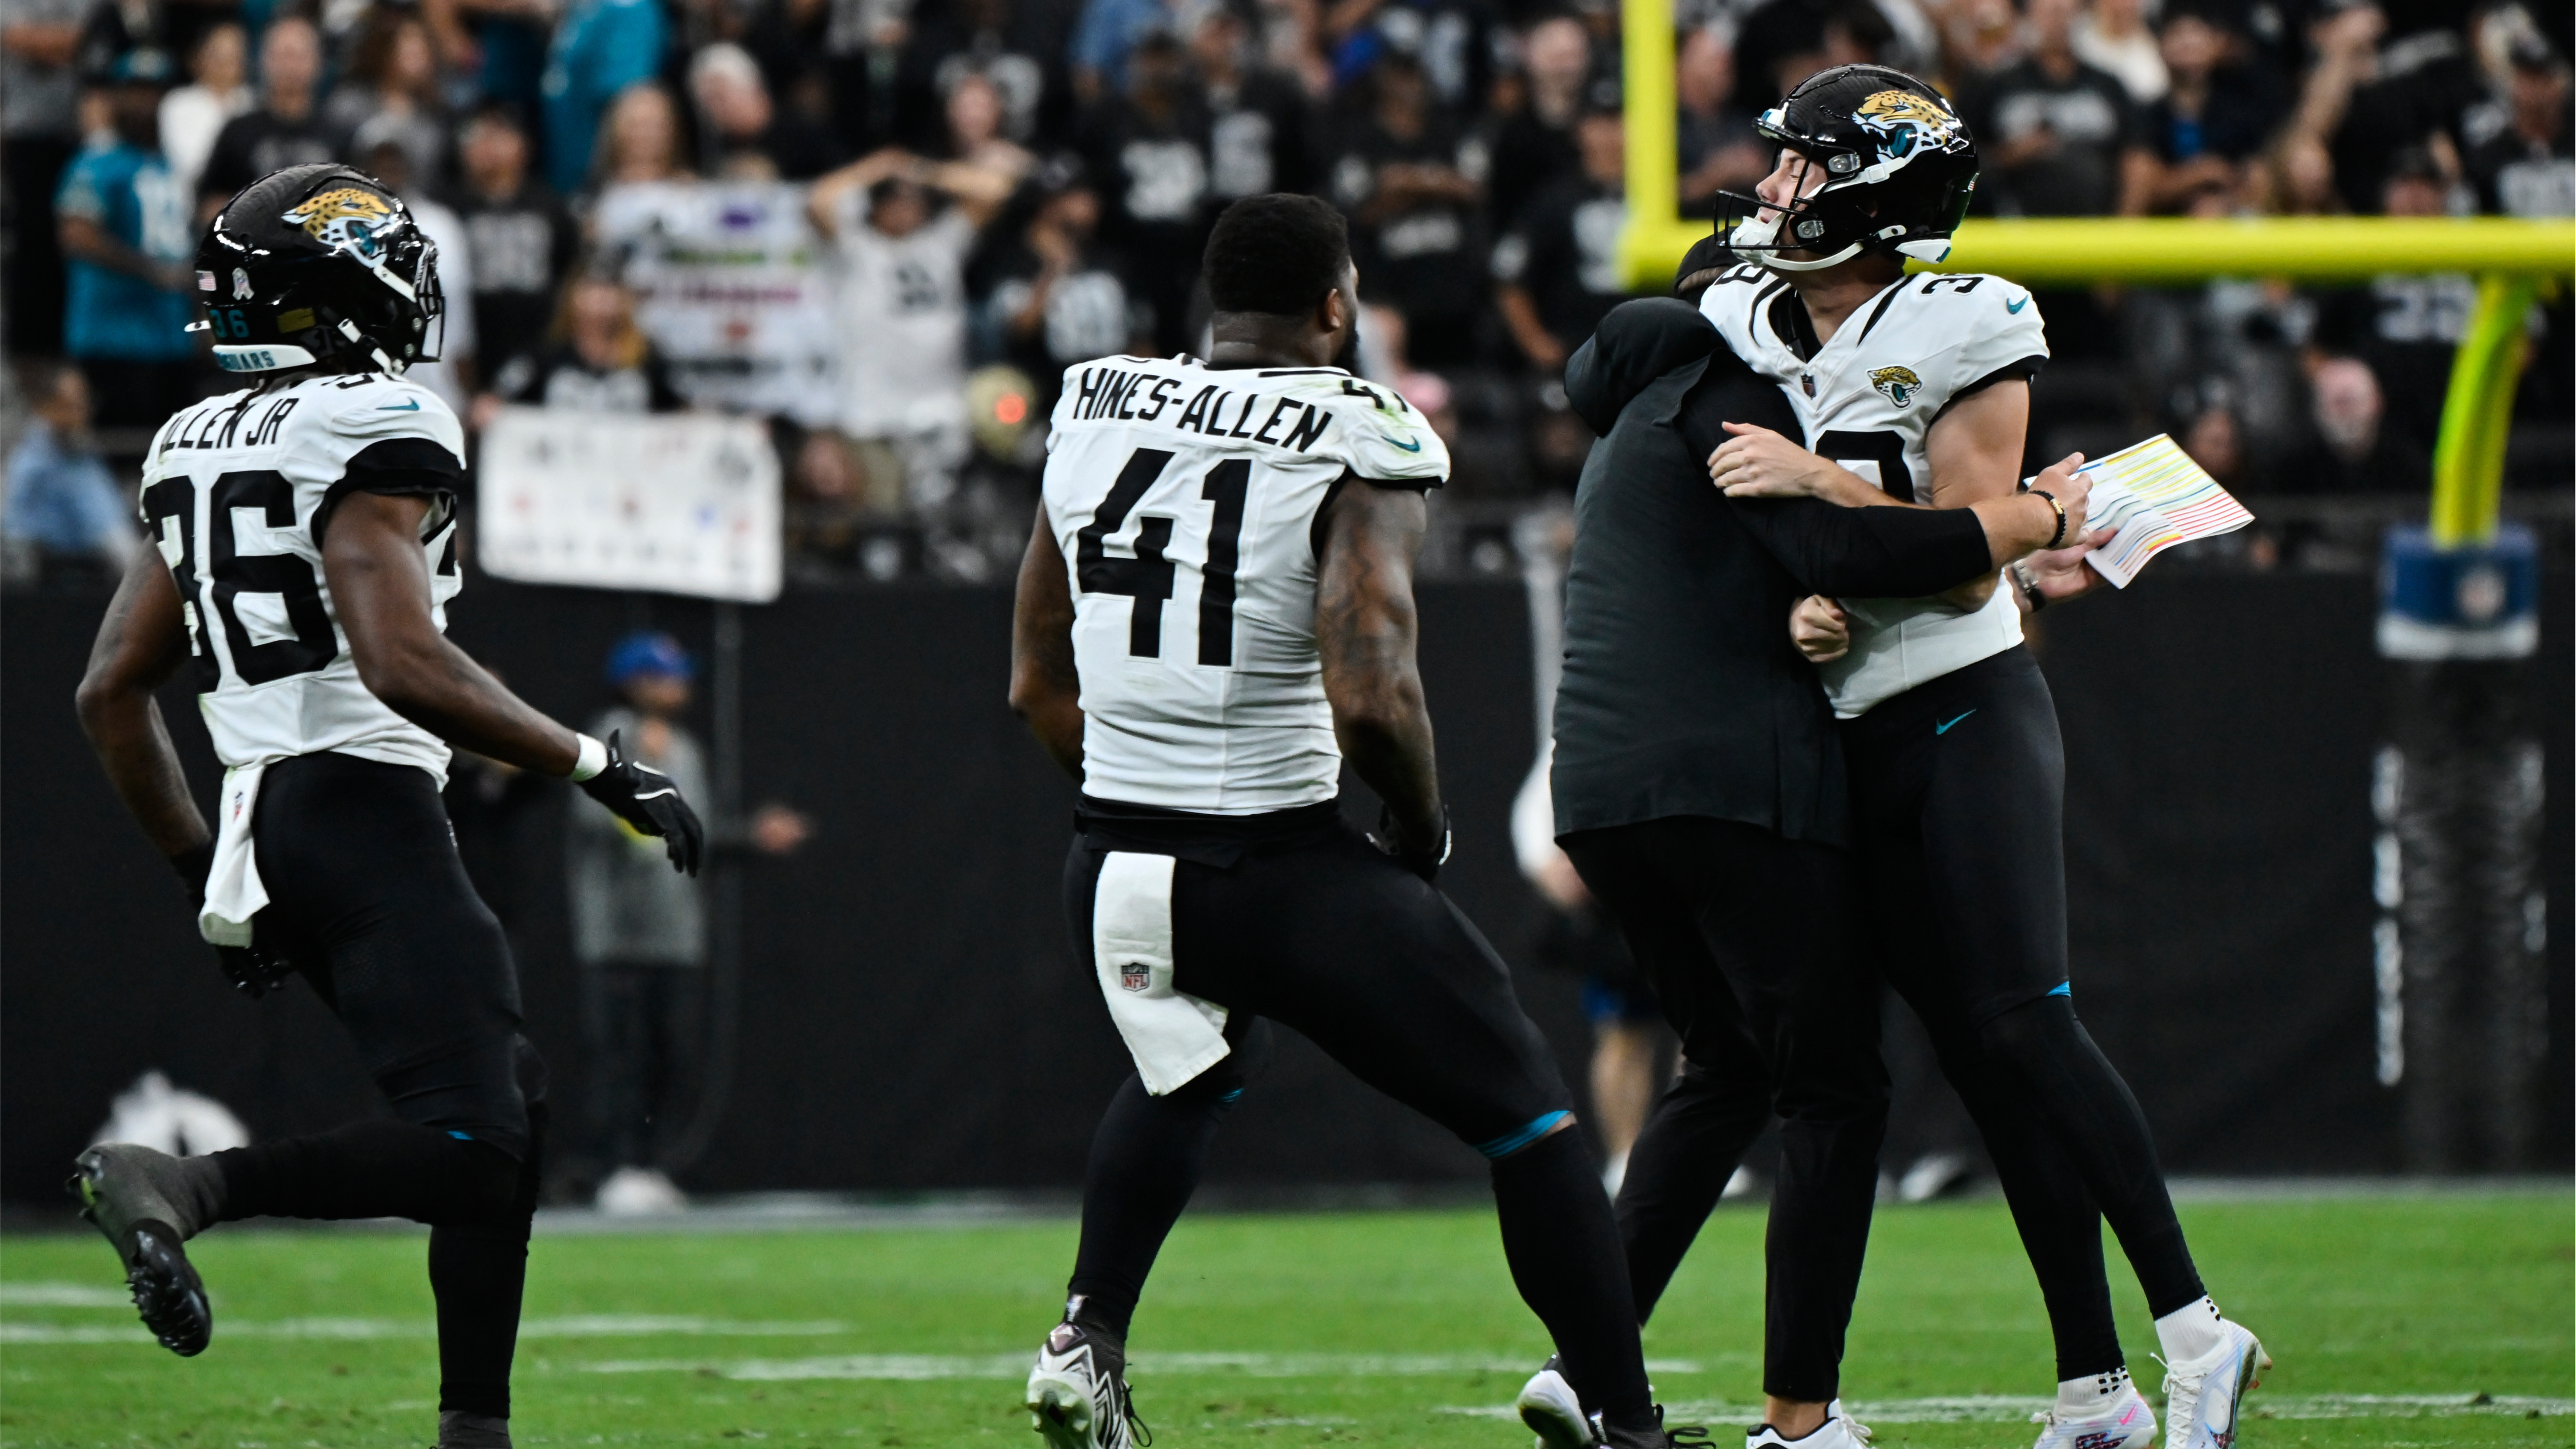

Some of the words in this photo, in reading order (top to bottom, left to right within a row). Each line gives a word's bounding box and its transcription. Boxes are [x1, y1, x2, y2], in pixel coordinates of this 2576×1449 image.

[1921, 274, 1984, 294] 3
[210, 309, 250, 338] 36
[1073, 368, 1333, 453] HINES-ALLEN
[1342, 380, 1409, 413] 41
[246, 398, 299, 446] JR
[144, 470, 338, 692] 36
[1076, 448, 1252, 666] 41
